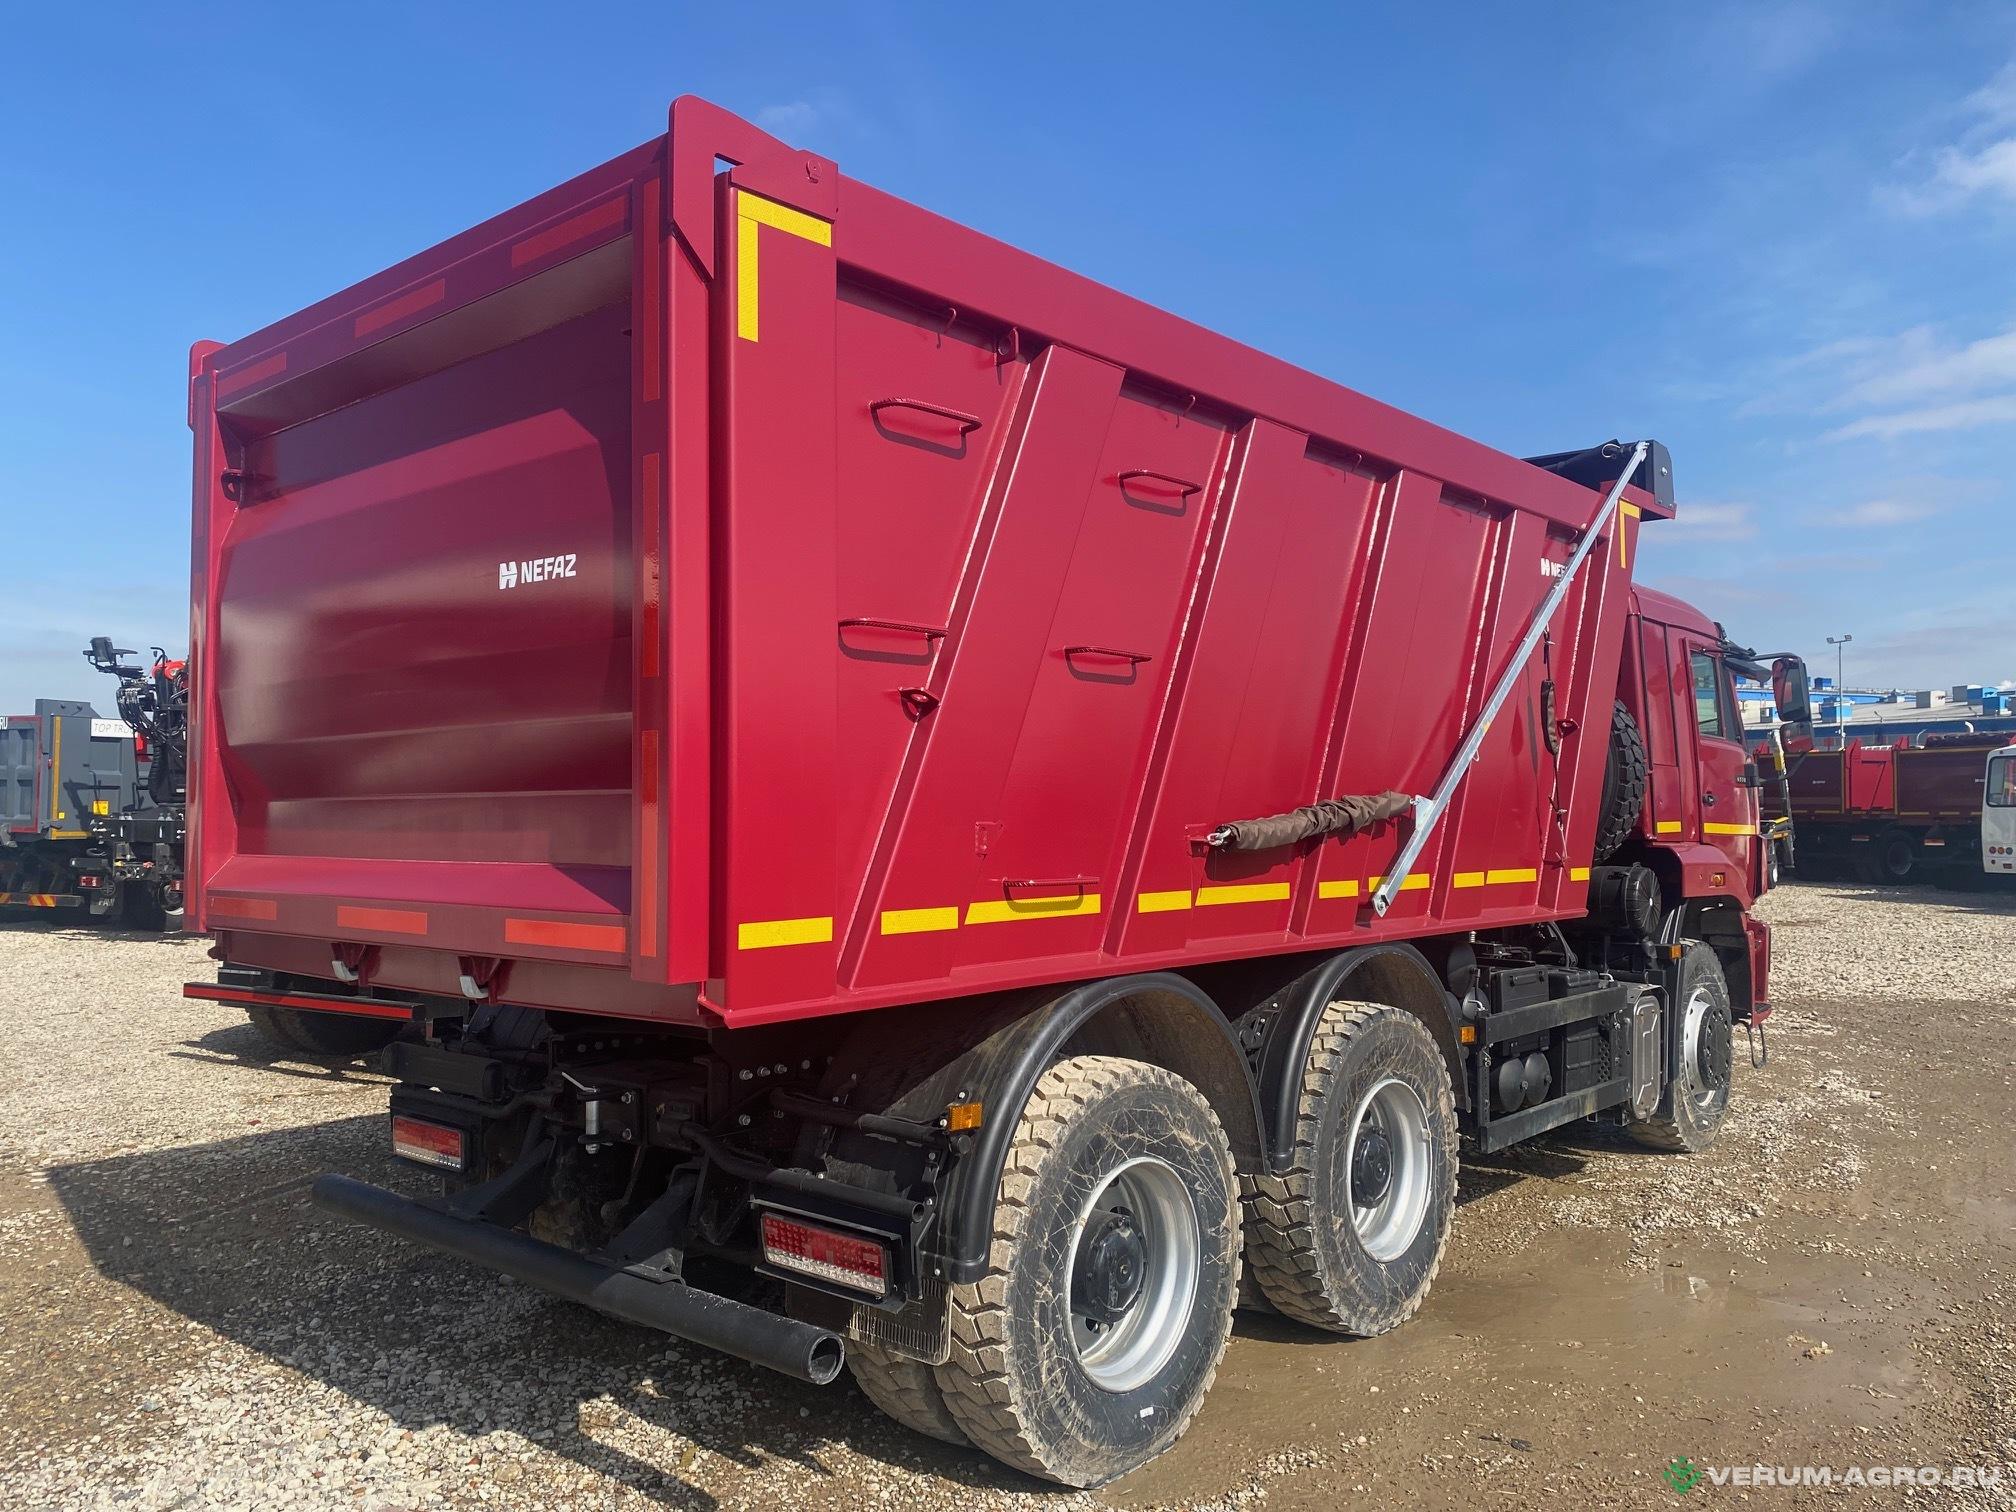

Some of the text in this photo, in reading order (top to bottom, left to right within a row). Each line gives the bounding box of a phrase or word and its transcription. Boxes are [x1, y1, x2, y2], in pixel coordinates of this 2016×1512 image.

[521, 554, 576, 583] NEFAZ
[95, 723, 133, 734] TOP TRU
